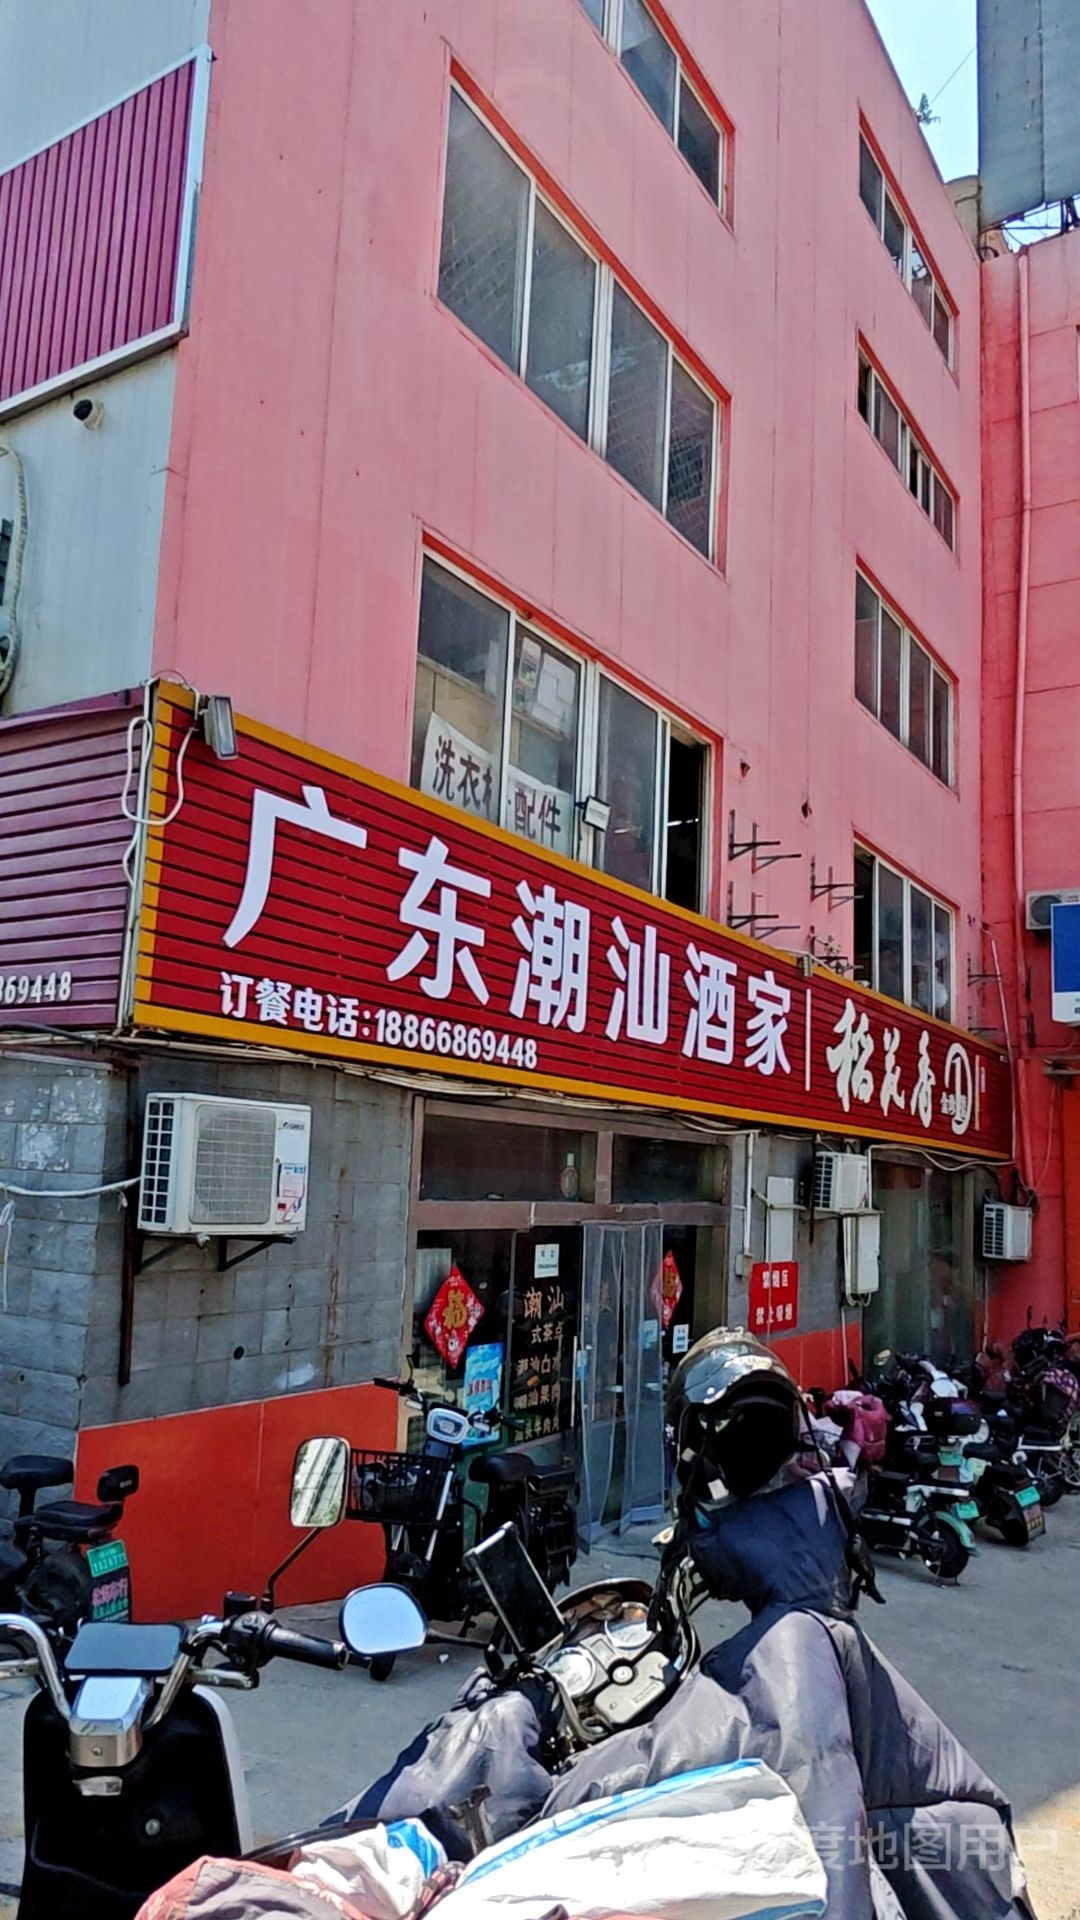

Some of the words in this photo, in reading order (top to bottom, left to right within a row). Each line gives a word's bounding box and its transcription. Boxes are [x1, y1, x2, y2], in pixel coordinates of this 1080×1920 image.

[222, 786, 794, 1078] 广东潮汕酒家
[219, 971, 539, 1071] 订餐电话:18866869448
[523, 1284, 565, 1320] 潮汕
